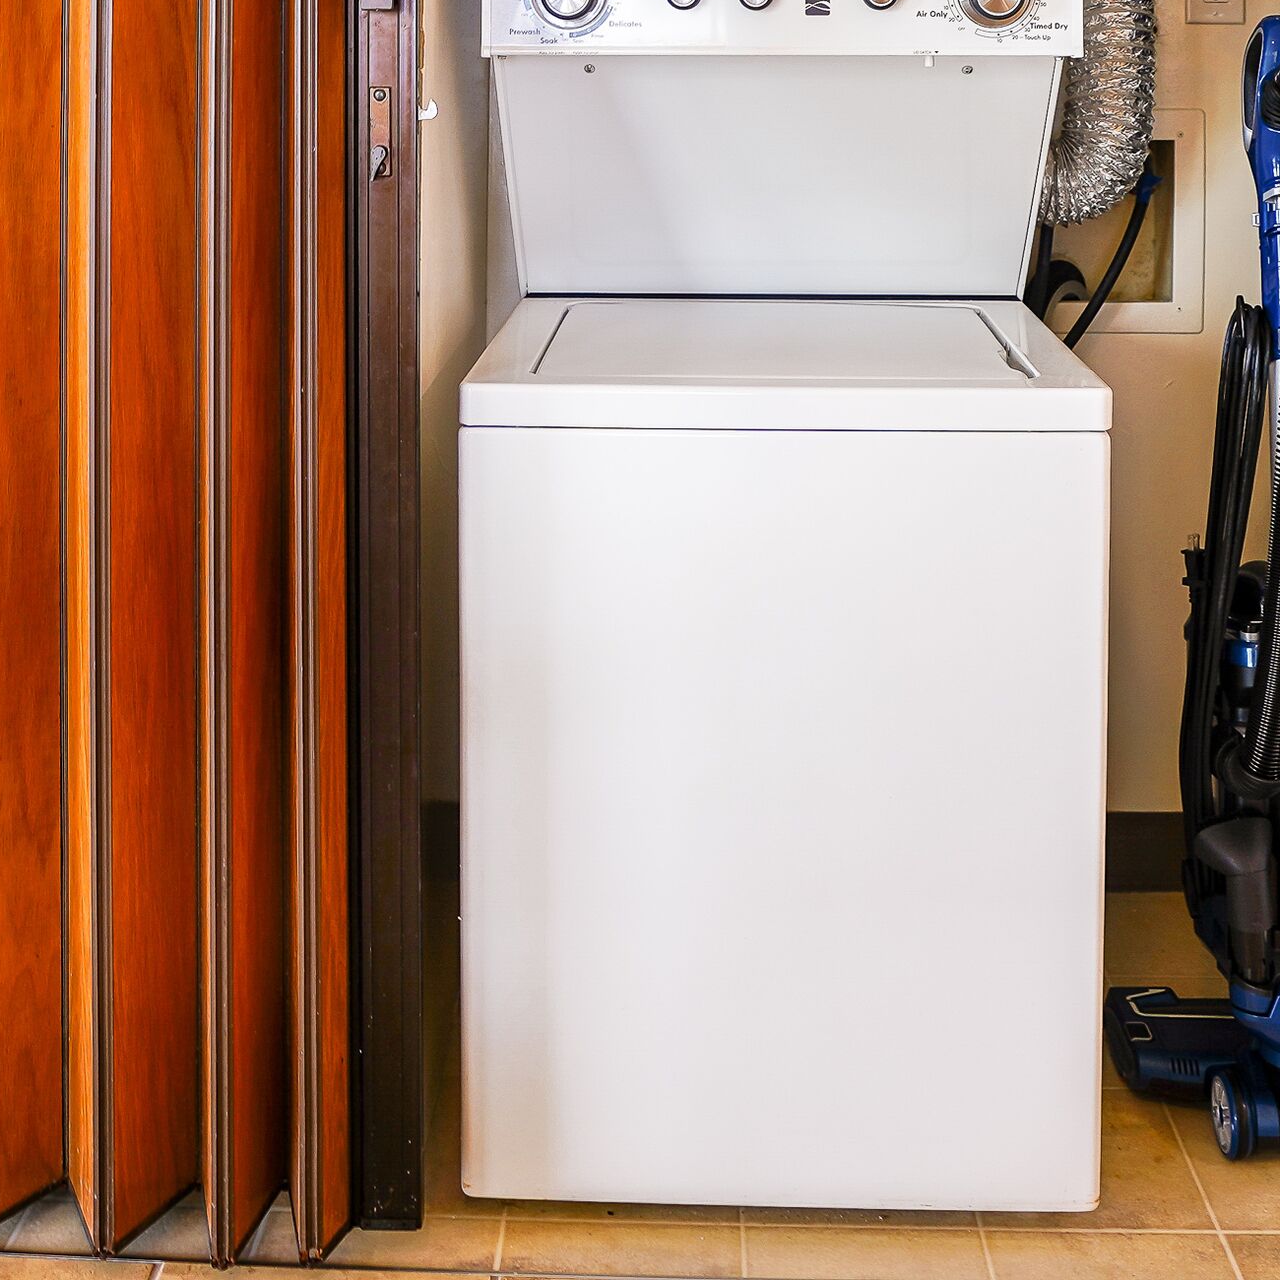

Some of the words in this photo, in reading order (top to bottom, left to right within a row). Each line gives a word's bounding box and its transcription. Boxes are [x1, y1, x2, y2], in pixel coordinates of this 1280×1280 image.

[930, 11, 948, 19] Only
[1054, 23, 1068, 31] Dry
[509, 28, 541, 36] Prewash
[540, 37, 558, 45] Soak
